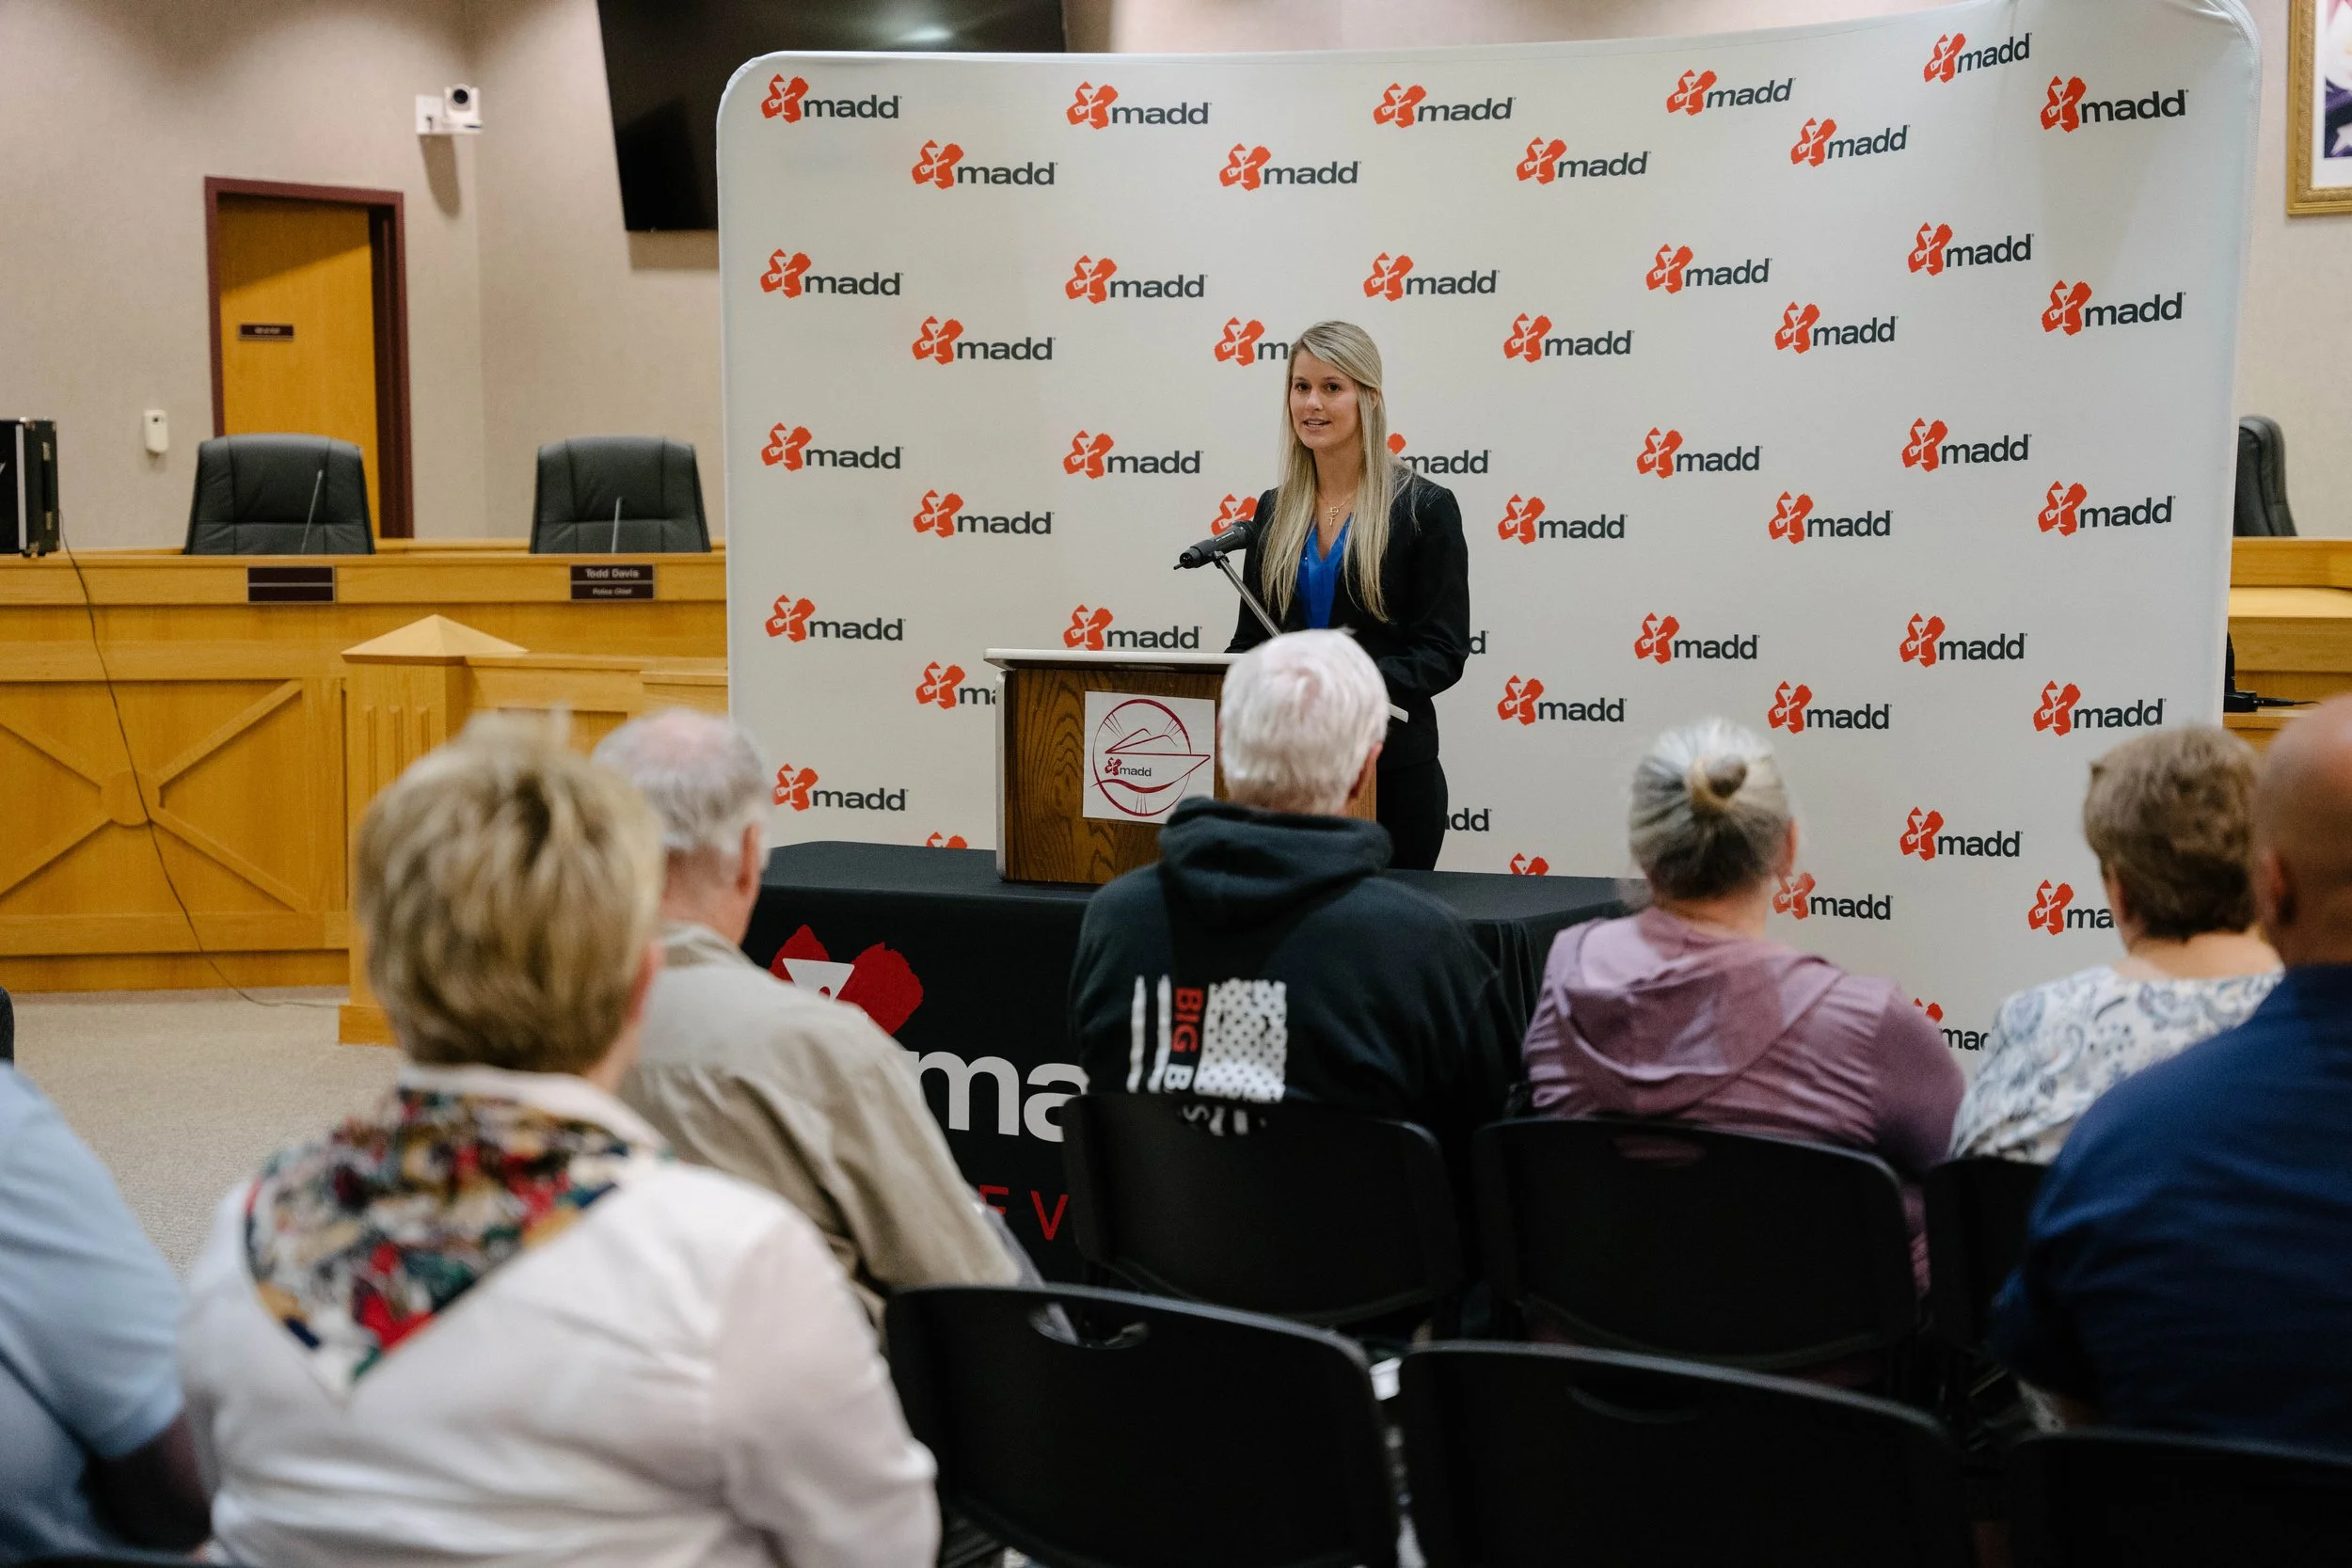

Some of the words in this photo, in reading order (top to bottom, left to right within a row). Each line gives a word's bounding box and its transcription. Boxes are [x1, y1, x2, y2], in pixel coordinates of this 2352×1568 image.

[1957, 33, 2030, 73] madd
[1705, 78, 1796, 108] madd
[804, 95, 901, 119] madd
[1111, 102, 1210, 125] madd
[1418, 97, 1516, 121] madd
[2081, 89, 2188, 123] madd
[1828, 125, 1910, 159] madd
[958, 162, 1057, 185] madd
[1264, 161, 1360, 184] madd
[1558, 151, 1650, 178] madd
[1947, 233, 2034, 267] madd
[805, 272, 903, 295] madd
[1406, 270, 1500, 294] madd
[1686, 258, 1772, 287] madd
[1110, 275, 1207, 298] madd
[2085, 292, 2185, 327] madd
[1545, 330, 1634, 356] madd
[1813, 316, 1898, 346] madd
[958, 337, 1055, 360] madd
[806, 446, 903, 469] madd
[1677, 446, 1762, 471] madd
[1942, 434, 2031, 464] madd
[1108, 451, 1203, 474] madd
[958, 512, 1054, 534] madd
[1807, 510, 1893, 537] madd
[2080, 496, 2175, 528] madd
[1539, 515, 1628, 539] madd
[585, 568, 610, 578] Todd
[810, 618, 905, 641] madd
[1107, 626, 1201, 649] madd
[1675, 634, 1759, 659] madd
[1939, 633, 2027, 660] madd
[1539, 698, 1627, 722] madd
[1807, 704, 1892, 729] madd
[2074, 698, 2166, 728] madd
[1120, 767, 1152, 777] madd
[813, 788, 908, 811] madd
[1445, 808, 1491, 832] dd
[1938, 831, 2023, 857] madd
[1811, 895, 1893, 920] madd
[2067, 909, 2115, 929] ma
[1172, 988, 1204, 1053] BIG
[901, 1050, 1091, 1143] ma
